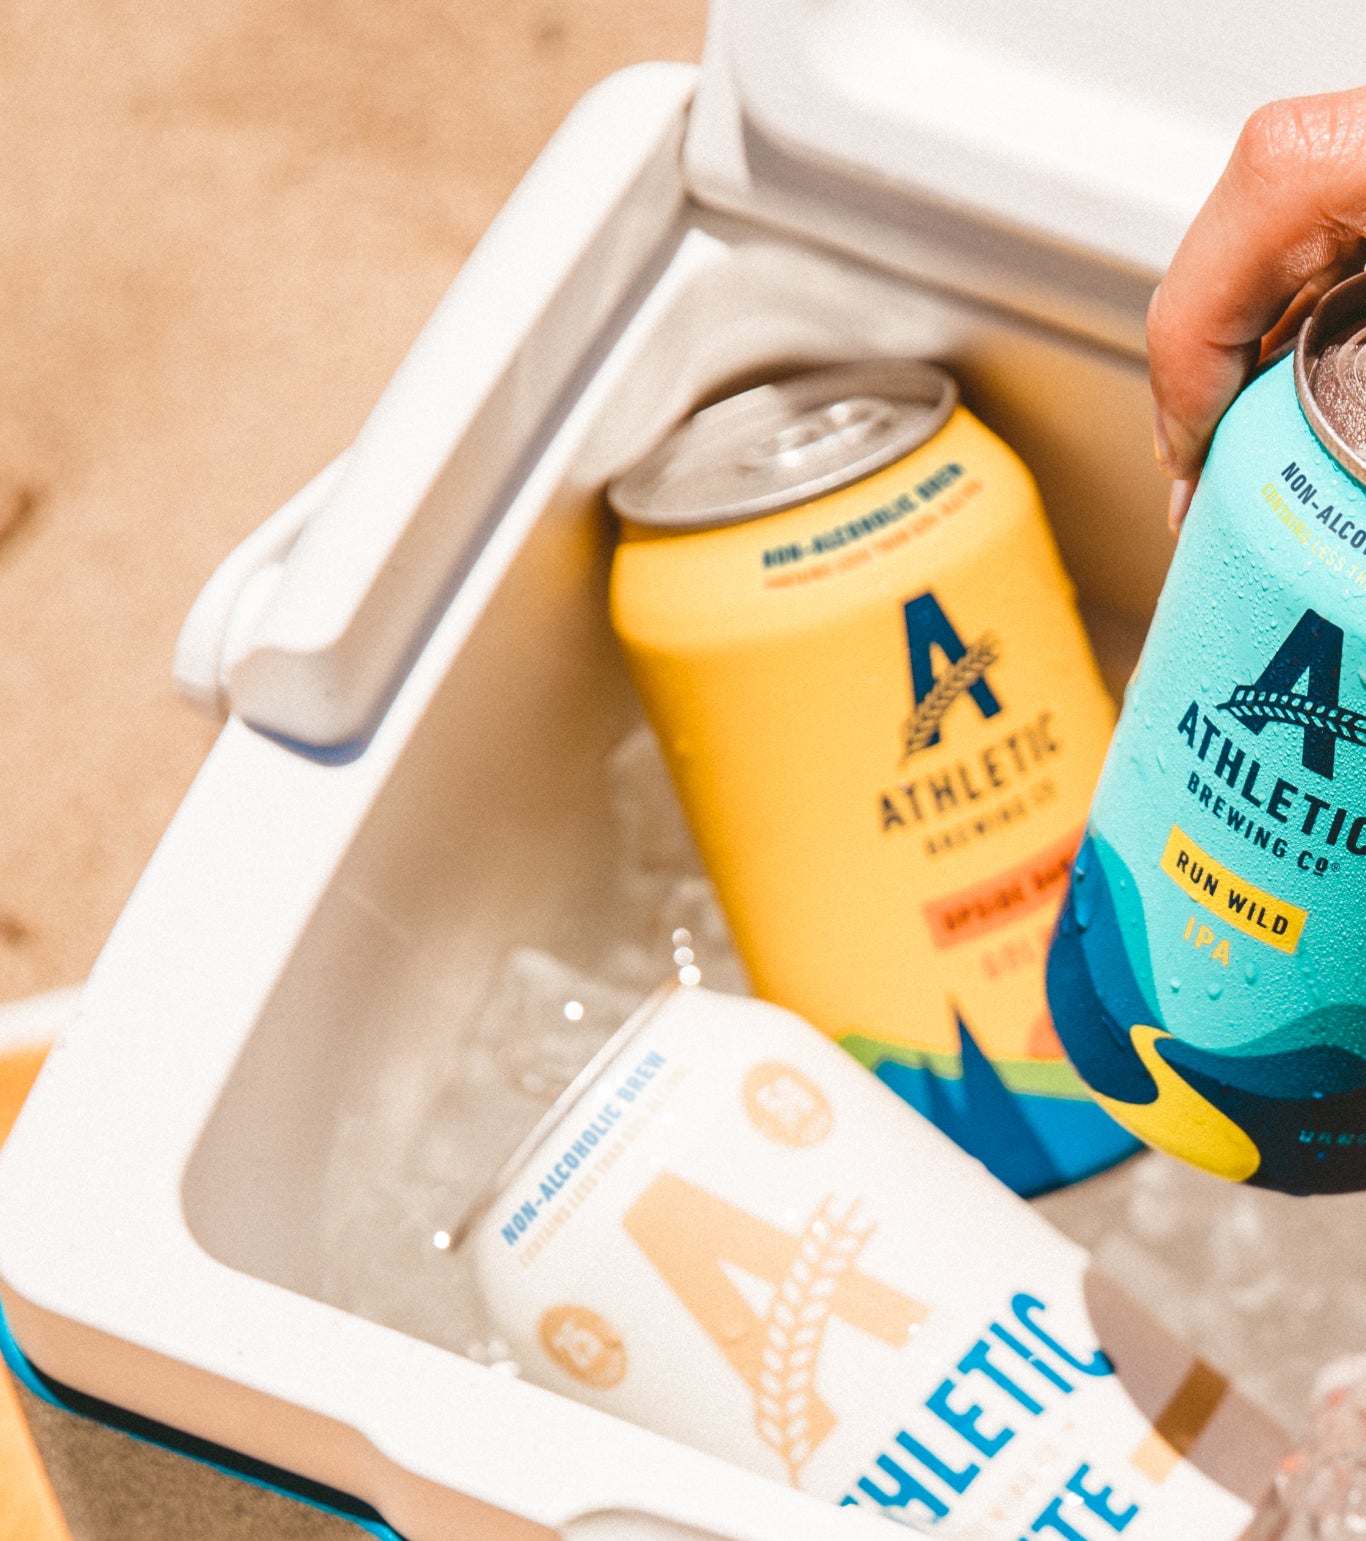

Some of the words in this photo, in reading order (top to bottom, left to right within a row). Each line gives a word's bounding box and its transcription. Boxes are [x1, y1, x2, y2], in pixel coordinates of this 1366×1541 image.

[1261, 482, 1314, 546] CONTAINS
[1310, 538, 1348, 572] LESS
[876, 711, 1060, 834] ATHLETIC
[1186, 770, 1288, 858] BREWING
[1176, 849, 1220, 898] RUN
[1227, 888, 1290, 936] WILD
[1183, 915, 1232, 968] IPA
[500, 1102, 622, 1246] NON-ALCOHOLIC
[615, 1050, 667, 1104] BREW
